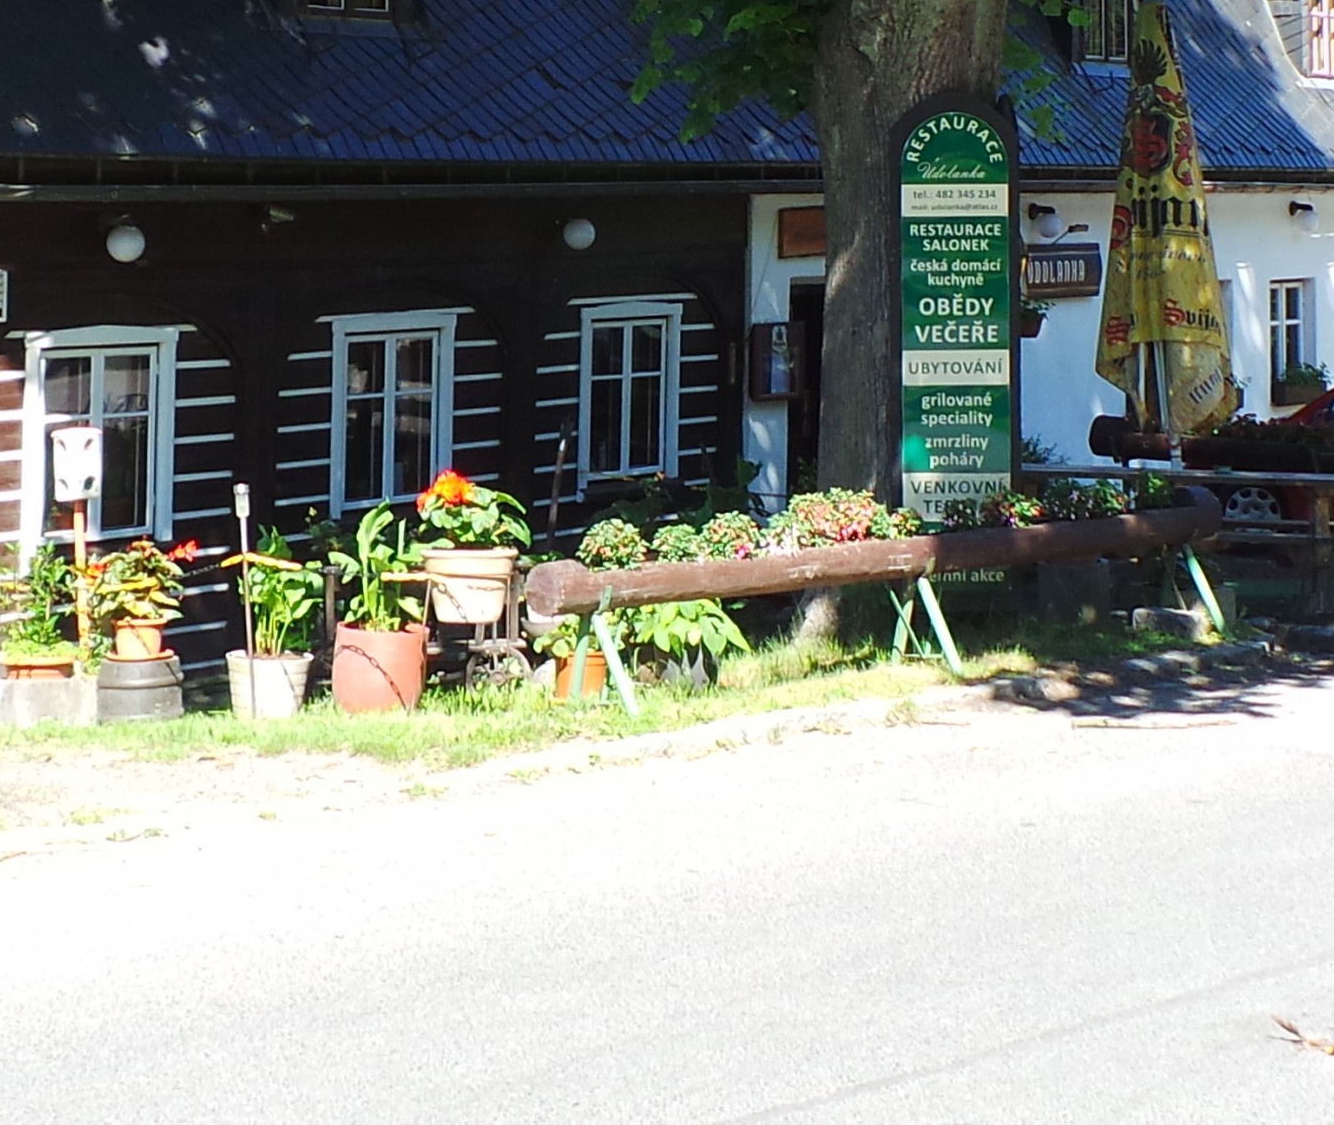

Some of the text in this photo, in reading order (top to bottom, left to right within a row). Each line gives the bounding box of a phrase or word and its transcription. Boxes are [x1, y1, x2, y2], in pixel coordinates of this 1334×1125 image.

[906, 116, 1003, 163] RESTAURACE
[917, 157, 986, 179] Údolanka
[935, 190, 954, 199] 482
[957, 190, 975, 199] 345
[978, 190, 996, 199] 234
[909, 223, 1002, 236] RESTAURACE
[922, 239, 989, 251] SALONEK
[910, 258, 1001, 271] česká domácí
[927, 273, 984, 288] kuchyně
[919, 293, 994, 316] OBĚDY
[914, 320, 999, 343] VEČEŘE
[908, 357, 1003, 374] UBYTOVÁNÍ
[921, 391, 992, 410] grilované
[921, 411, 992, 428] speciality
[925, 434, 989, 450] zmrzliny
[929, 451, 984, 469] poháry
[910, 477, 1004, 494] VENKOVNÍ
[970, 568, 1005, 582] akce
